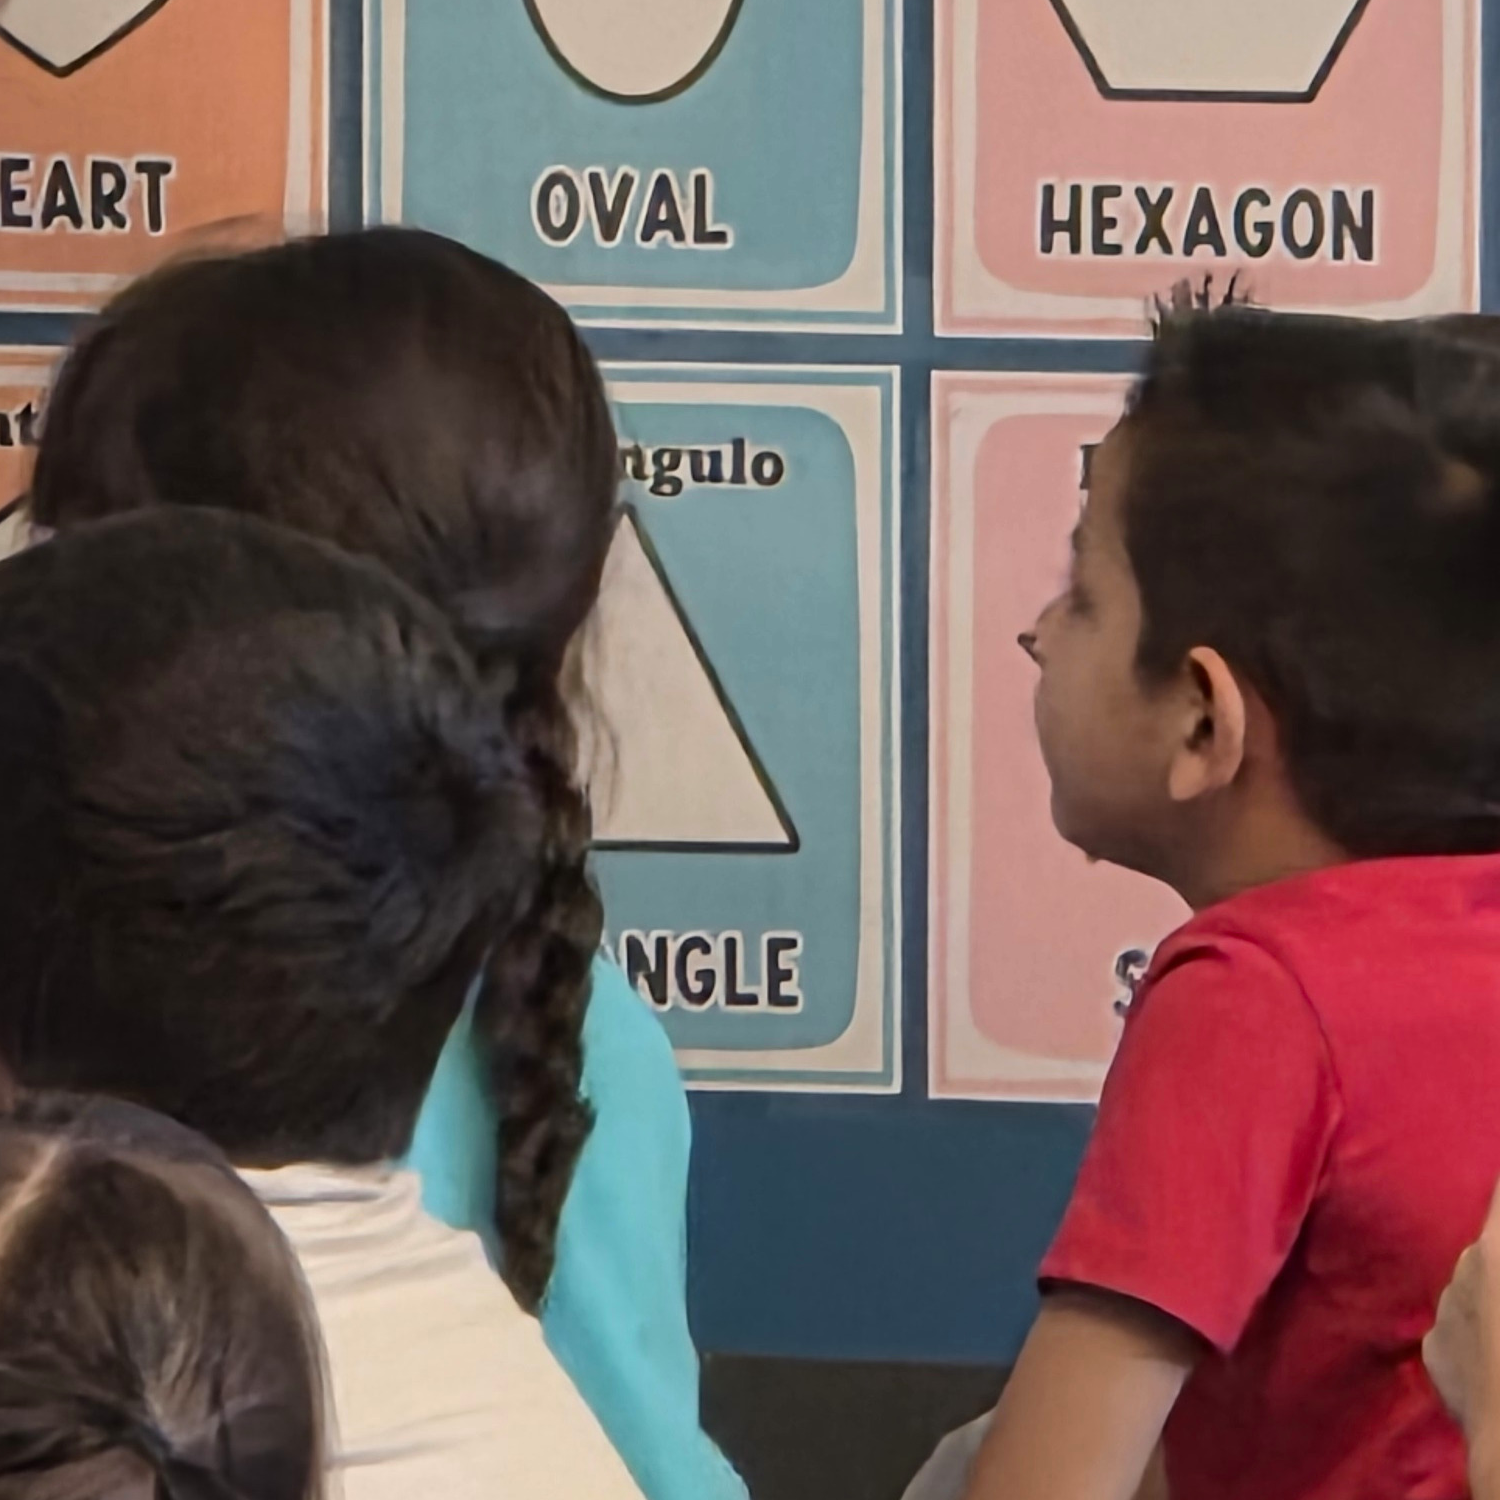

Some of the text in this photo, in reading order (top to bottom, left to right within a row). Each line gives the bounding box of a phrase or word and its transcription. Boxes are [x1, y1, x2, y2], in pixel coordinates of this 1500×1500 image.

[536, 171, 728, 245] OVAL
[1040, 183, 1375, 261] HEXAGON
[625, 934, 799, 1007] NGLE
